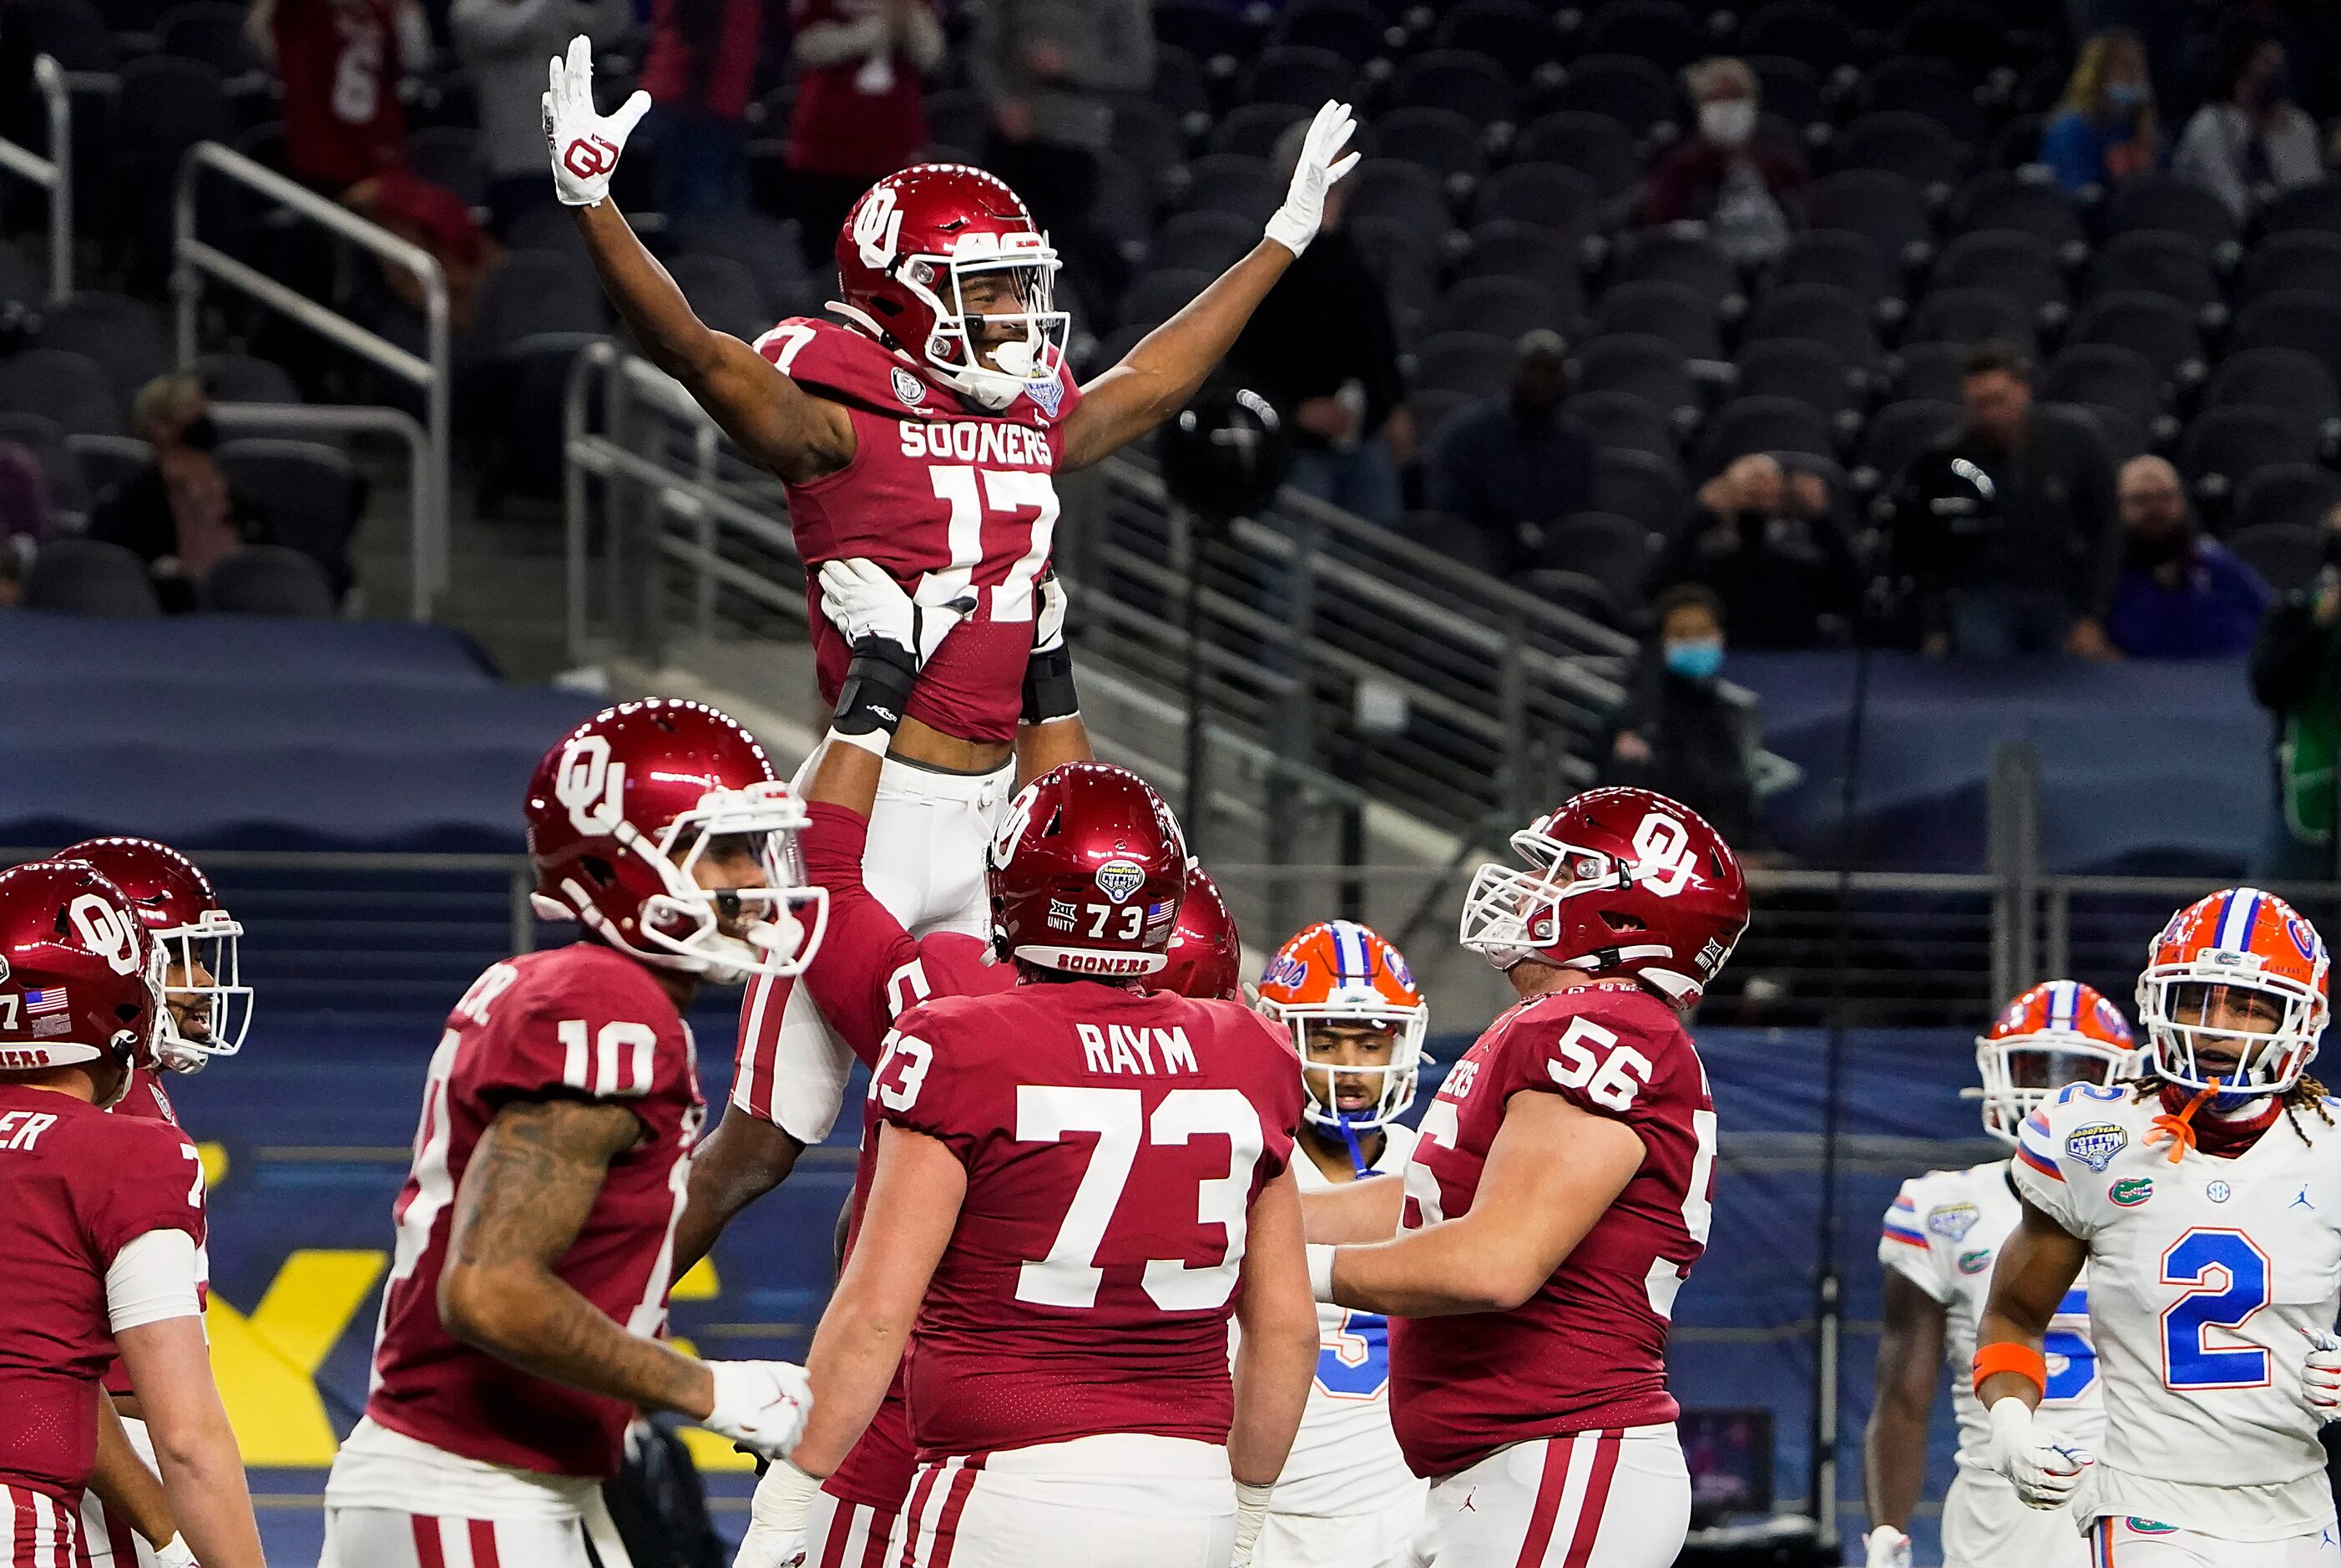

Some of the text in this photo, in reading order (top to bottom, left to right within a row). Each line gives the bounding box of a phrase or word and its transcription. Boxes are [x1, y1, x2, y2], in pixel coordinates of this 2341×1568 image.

[899, 420, 1053, 465] SOONERS
[913, 464, 1060, 622] 17
[555, 735, 625, 836] OU
[1101, 873, 1141, 886] COTTON
[1104, 865, 1140, 874] GOODYEAR
[1632, 812, 1698, 898] OU
[69, 893, 140, 975] OU
[1048, 916, 1075, 933] UNITY
[1086, 903, 1143, 939] 73
[1057, 953, 1150, 973] SOONERS
[1694, 951, 1713, 970] UNITY
[558, 1019, 657, 1098] 10
[867, 1027, 933, 1112] 73
[1077, 1023, 1198, 1074] RAYM
[1547, 1015, 1653, 1112] 56
[2069, 1133, 2123, 1151] COTTON
[2070, 1125, 2121, 1139] GOODYEAR
[180, 1142, 206, 1209] 7
[1015, 1085, 1264, 1311] 73
[2208, 1182, 2229, 1202] SEC
[2161, 1227, 2271, 1391] 2
